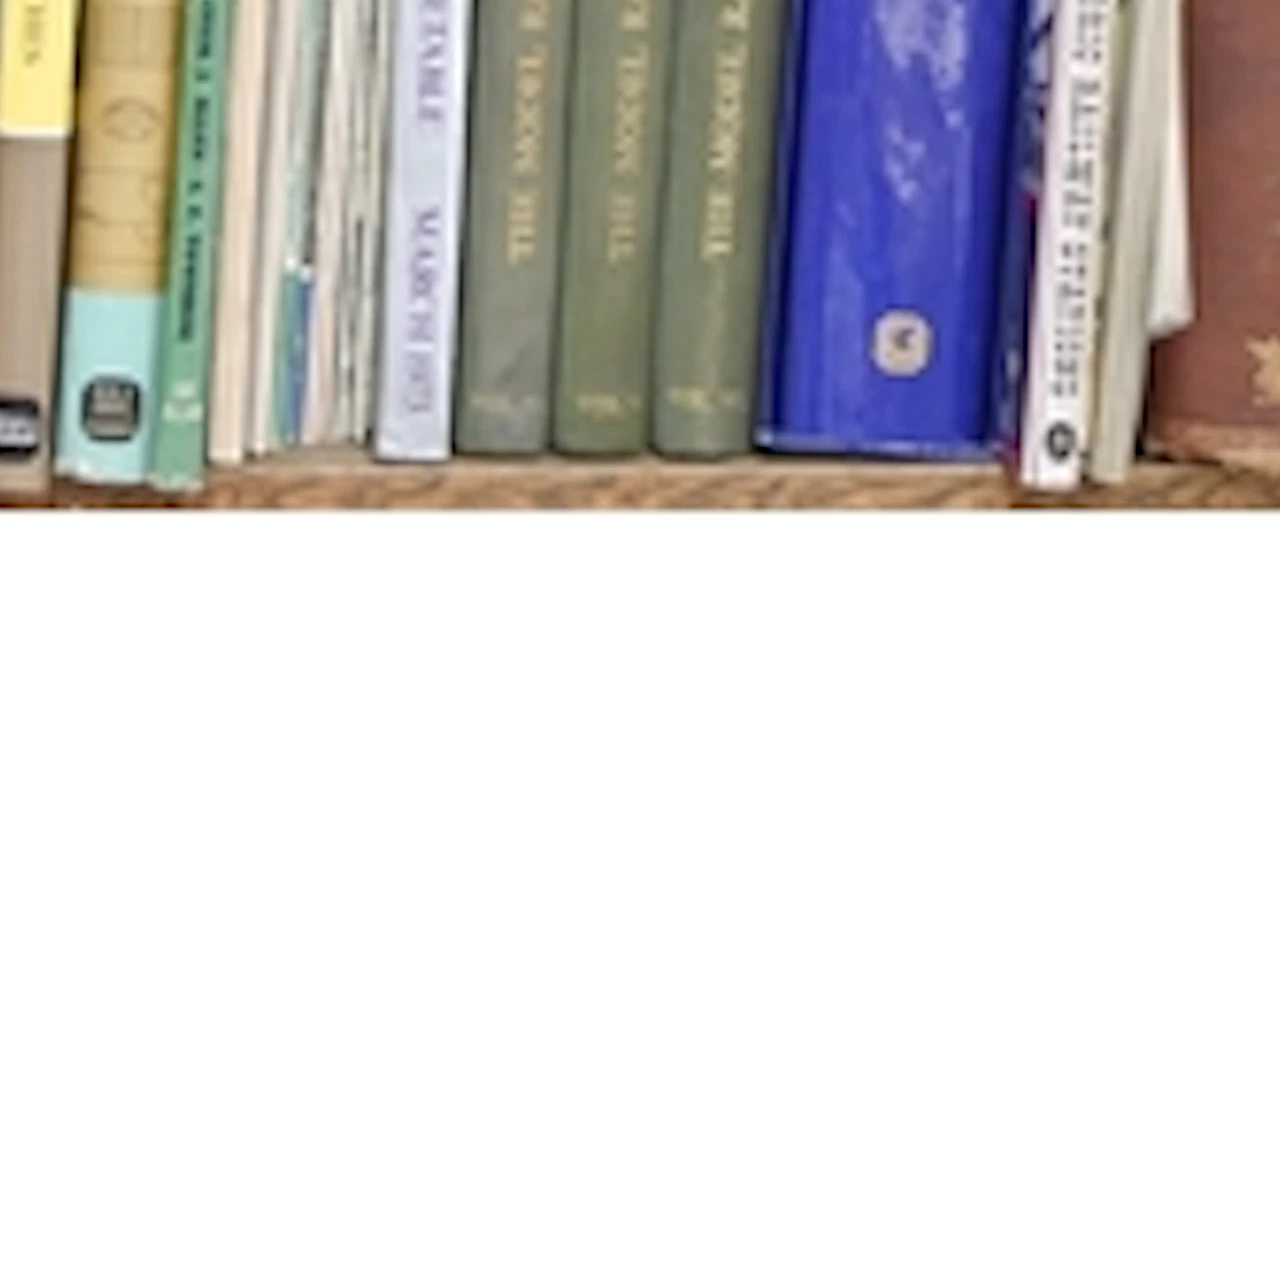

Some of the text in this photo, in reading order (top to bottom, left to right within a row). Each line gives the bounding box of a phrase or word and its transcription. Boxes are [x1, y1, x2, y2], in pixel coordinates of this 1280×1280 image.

[513, 45, 547, 177] MODEL
[611, 45, 649, 177] MODEL
[709, 42, 747, 174] MODEL
[508, 192, 536, 264] THE
[607, 194, 636, 264] THE
[704, 191, 737, 262] THE
